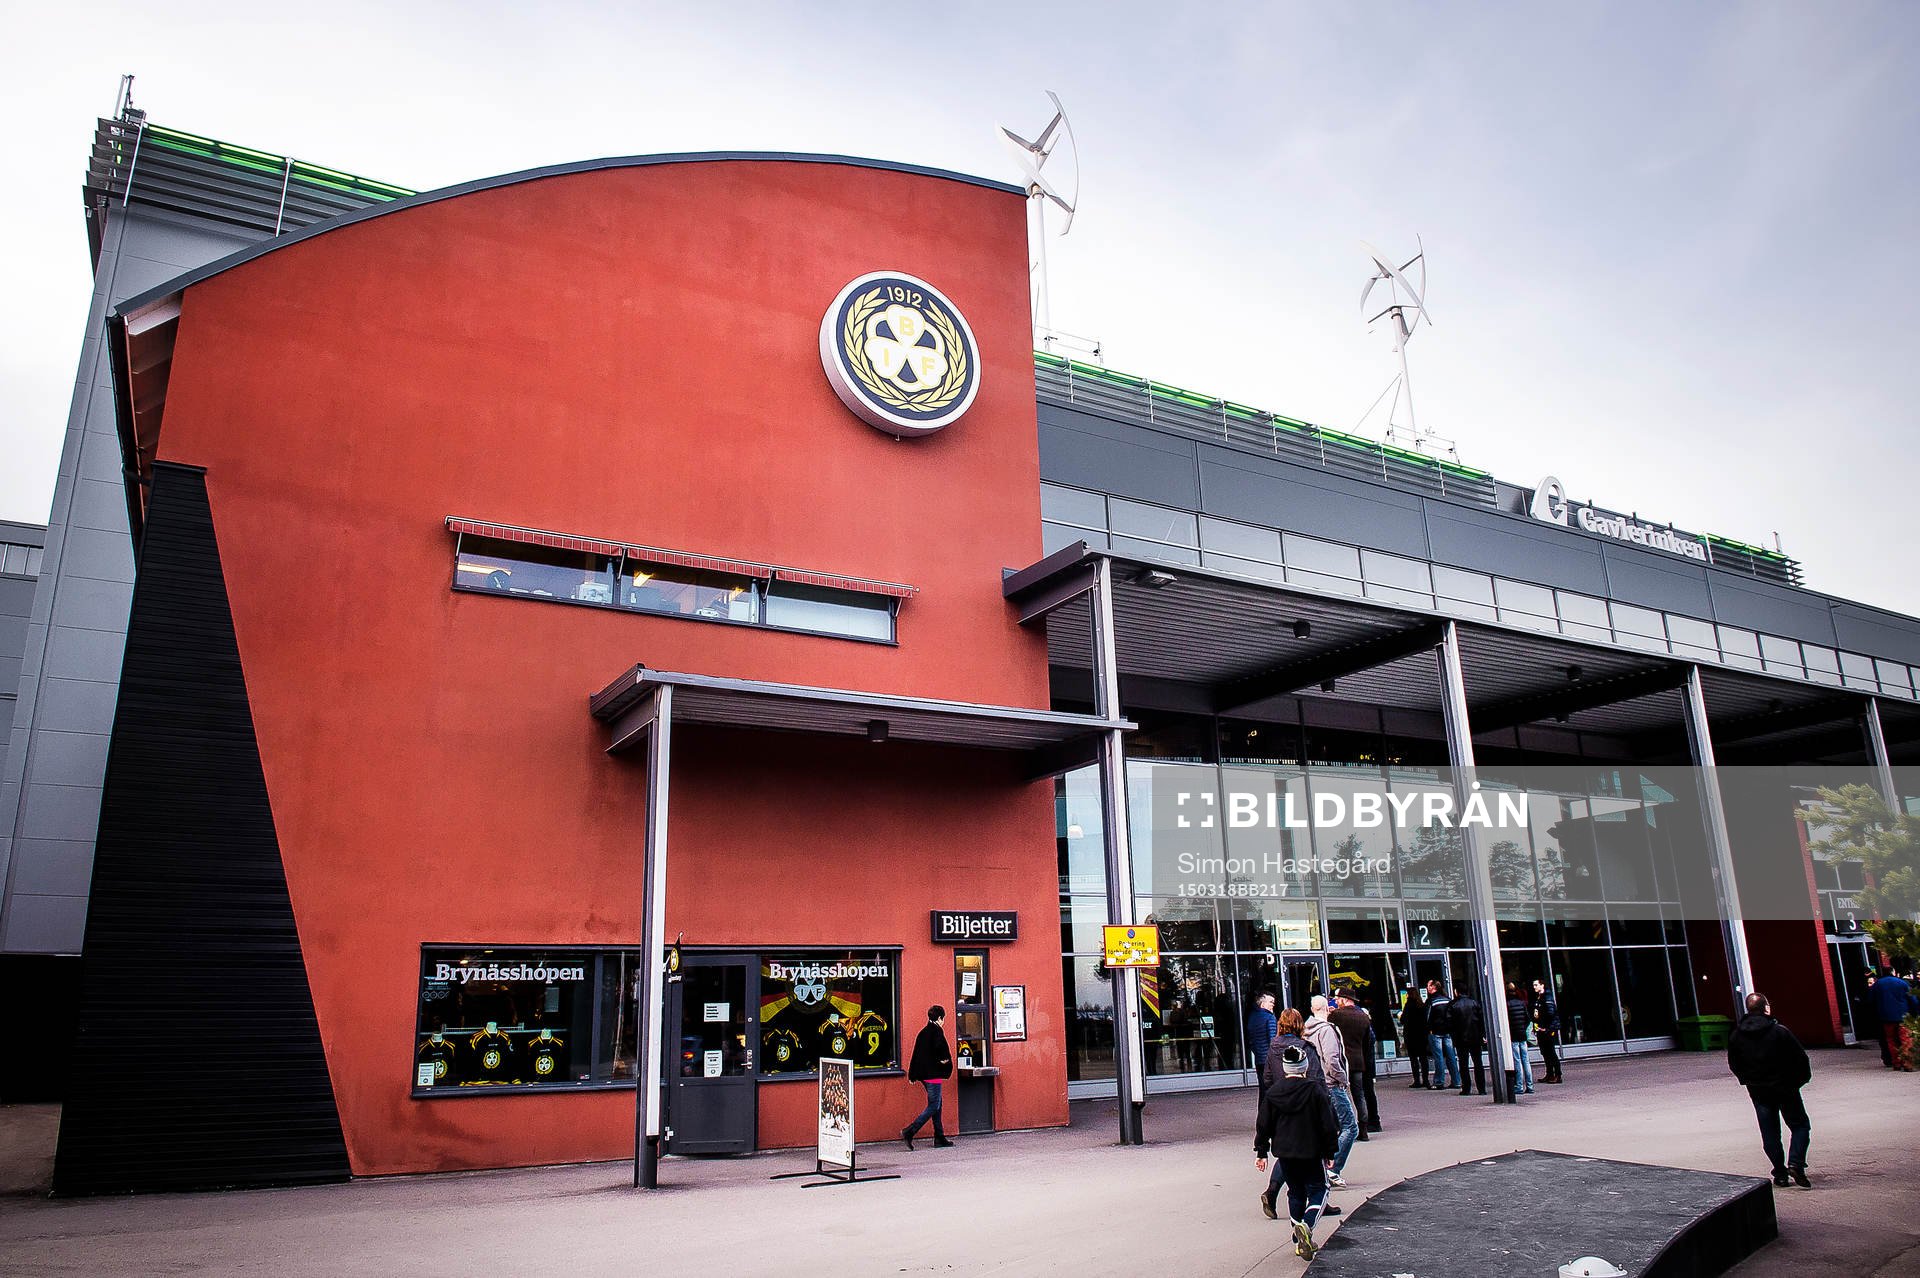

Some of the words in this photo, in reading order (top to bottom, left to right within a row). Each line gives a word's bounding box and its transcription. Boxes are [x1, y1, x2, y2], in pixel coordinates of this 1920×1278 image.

[886, 286, 923, 308] 1912
[900, 316, 915, 337] B
[1577, 507, 1707, 562] Gavlerinken
[1836, 897, 1860, 909] ENTR
[941, 915, 1012, 937] Biljetter
[1847, 911, 1857, 931] 3
[1418, 924, 1431, 946] 2
[435, 963, 584, 984] Brynässhopen
[769, 962, 889, 982] Brynässhopen
[868, 1032, 880, 1055] 9
